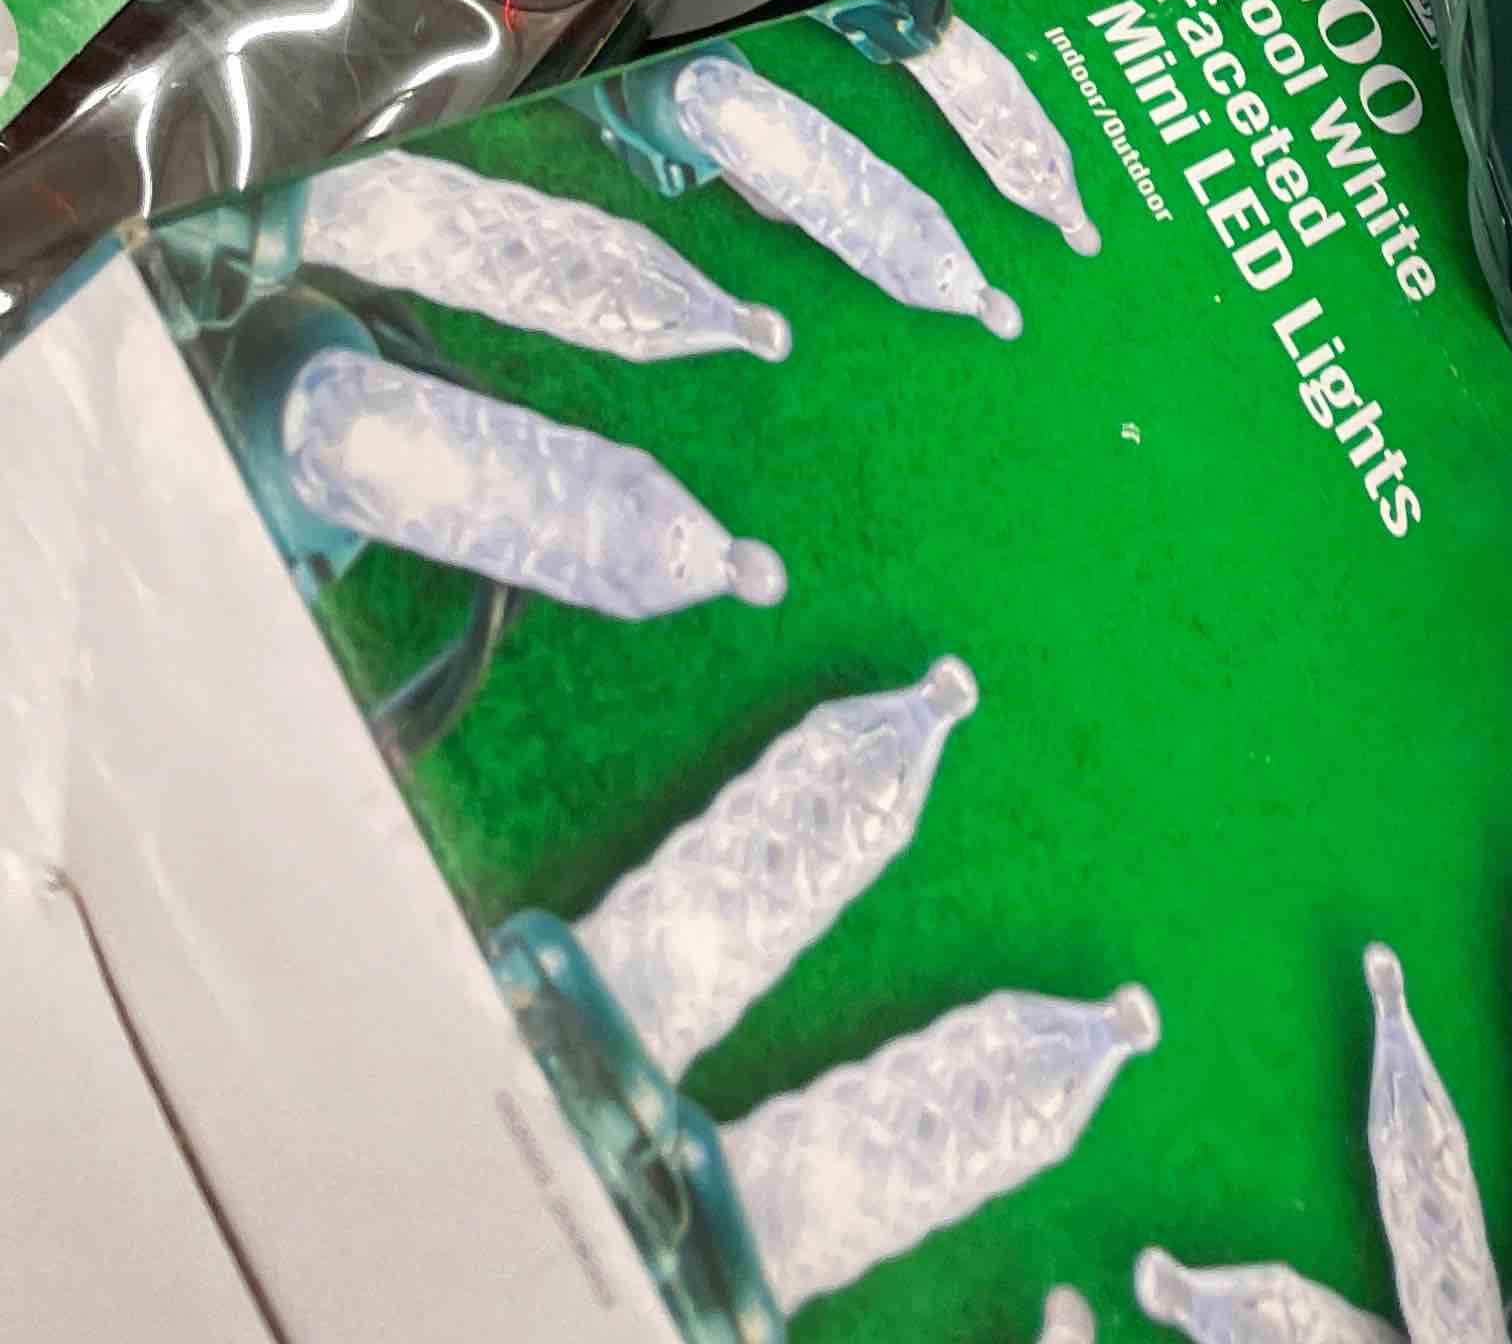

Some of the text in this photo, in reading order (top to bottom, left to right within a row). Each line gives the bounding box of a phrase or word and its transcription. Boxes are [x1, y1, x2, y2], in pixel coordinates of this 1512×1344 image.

[1044, 26, 1173, 223] Indoor/Outdoor
[1309, 96, 1438, 302] White
[1184, 147, 1294, 293] LED
[1271, 297, 1422, 538] Lights
